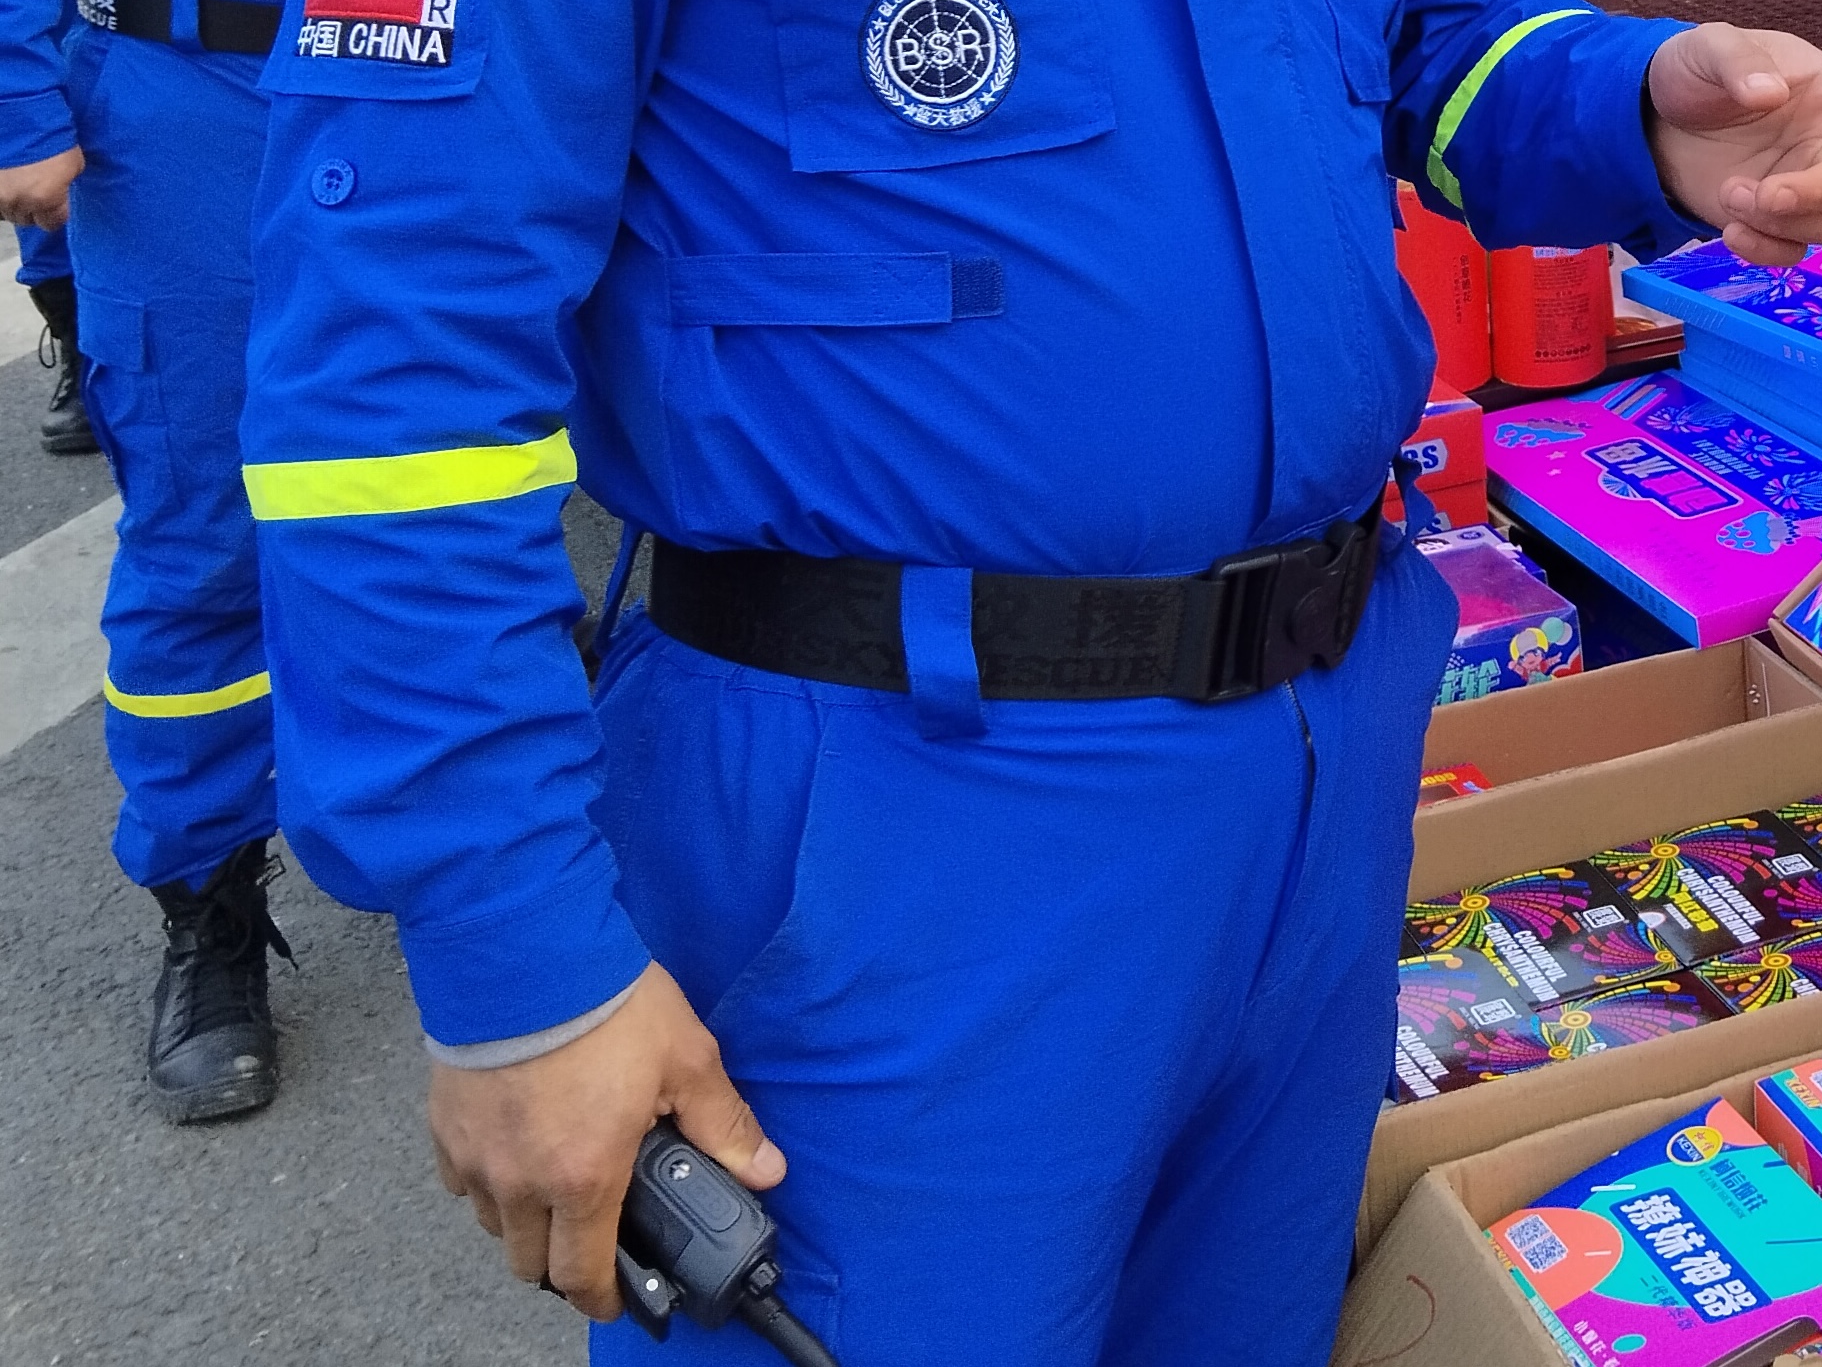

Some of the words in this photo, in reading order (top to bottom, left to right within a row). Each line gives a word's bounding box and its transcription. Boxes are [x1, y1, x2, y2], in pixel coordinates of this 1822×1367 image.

[298, 18, 342, 58] 中国
[349, 22, 448, 64] CHINA
[896, 29, 985, 71] BSR
[1708, 875, 1765, 926] COLOURFUL
[1514, 930, 1568, 983] COLOURFUL
[1398, 1025, 1450, 1080] COLOURFUL
[1784, 1077, 1822, 1109] KEXIN
[1675, 1134, 1702, 1162] KEXIN
[1619, 1194, 1758, 1318] 撩妹神器
